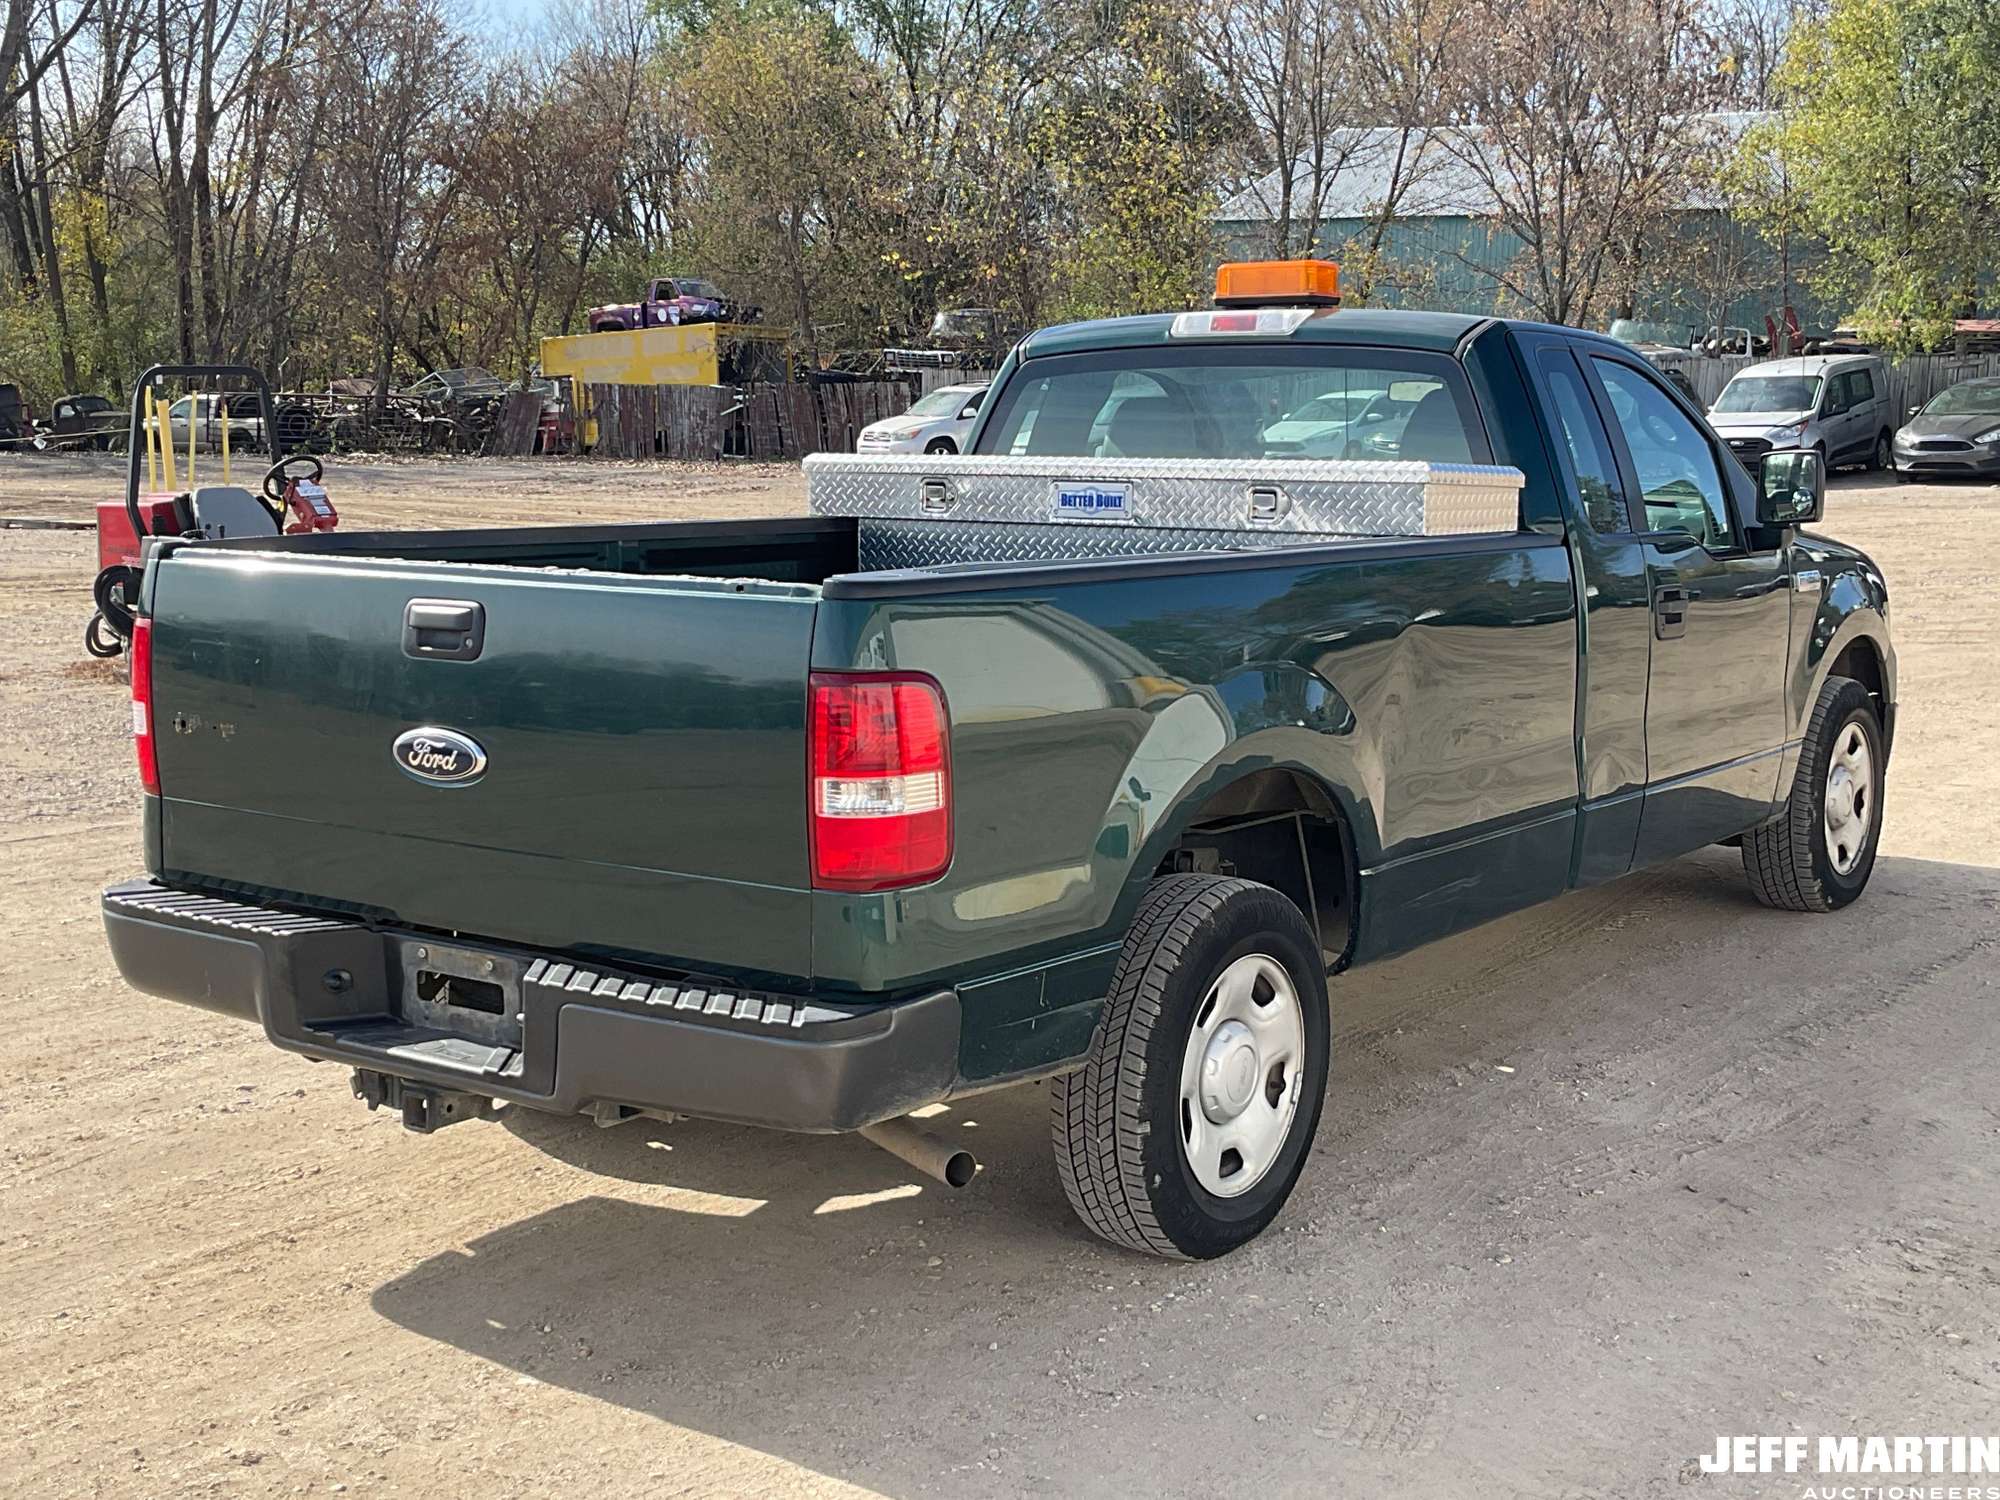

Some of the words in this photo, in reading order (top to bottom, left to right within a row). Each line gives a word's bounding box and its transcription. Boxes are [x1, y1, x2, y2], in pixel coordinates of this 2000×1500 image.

[1061, 493, 1094, 507] BETTER
[1096, 494, 1122, 508] BUILT
[408, 738, 458, 770] Ford
